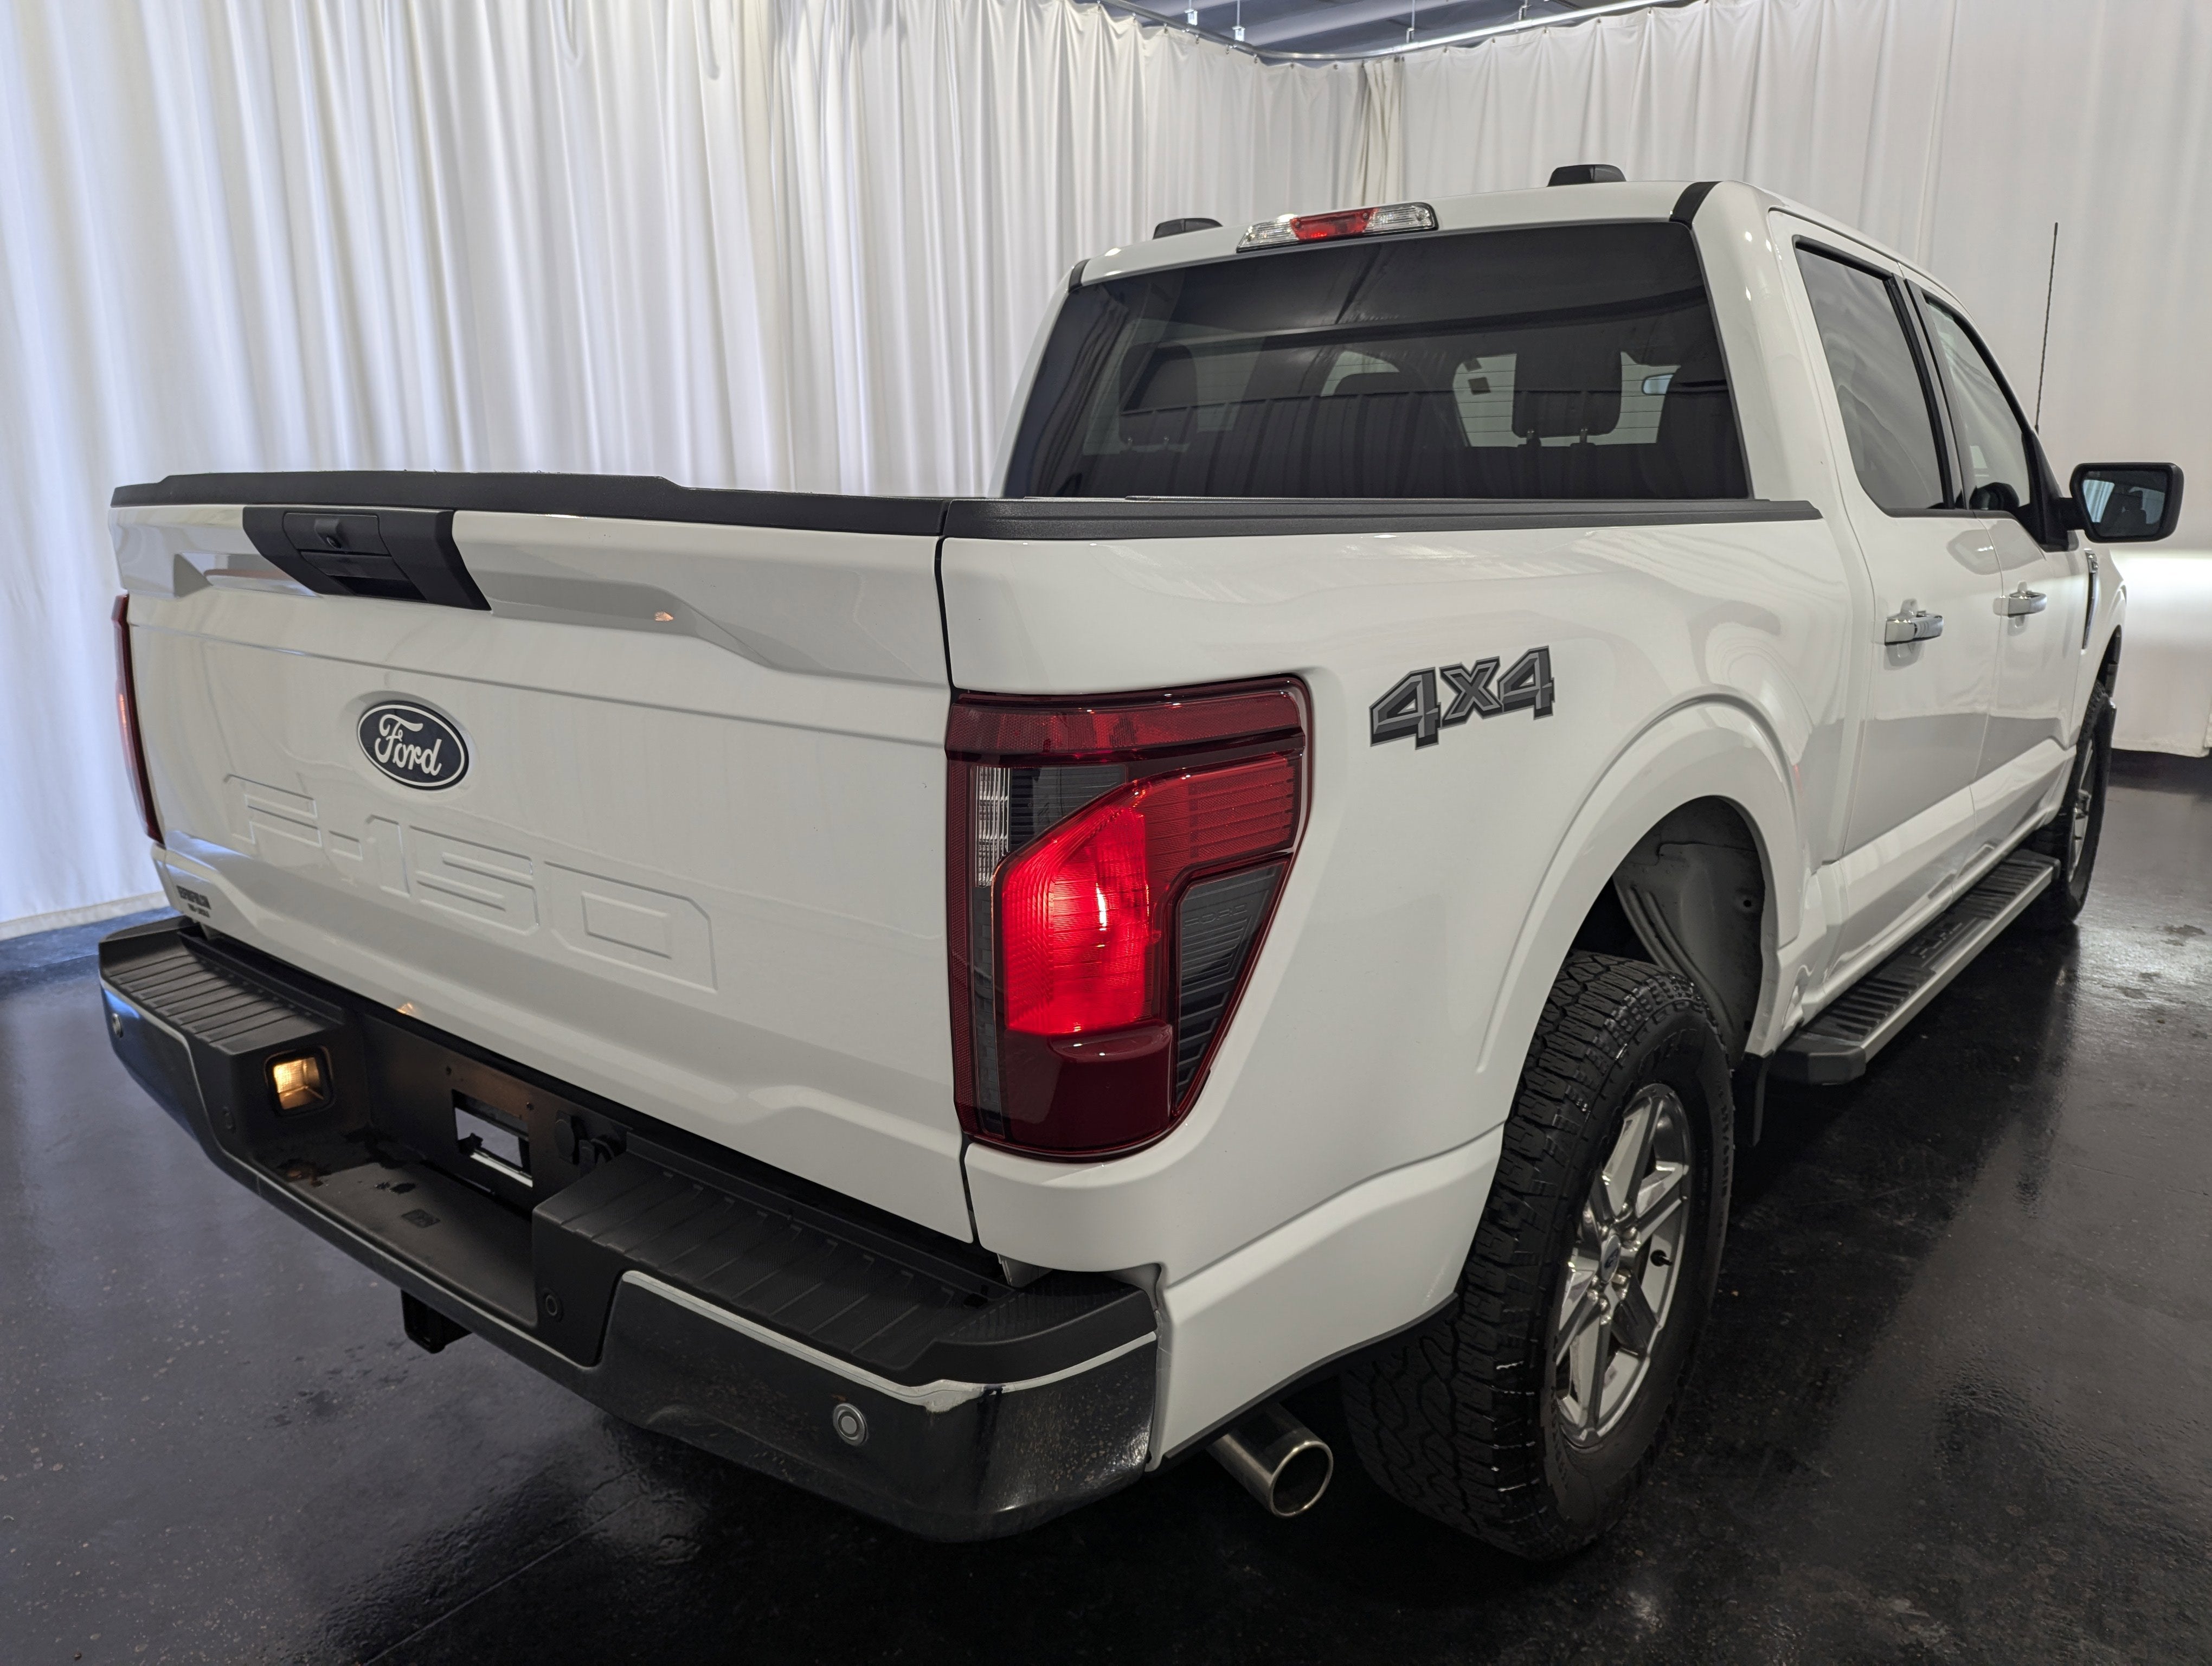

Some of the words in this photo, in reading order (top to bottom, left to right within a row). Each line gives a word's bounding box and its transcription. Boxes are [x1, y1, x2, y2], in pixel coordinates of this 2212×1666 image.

[375, 714, 442, 776] Ford
[223, 774, 718, 994] F-150
[1181, 902, 1248, 930] FORD
